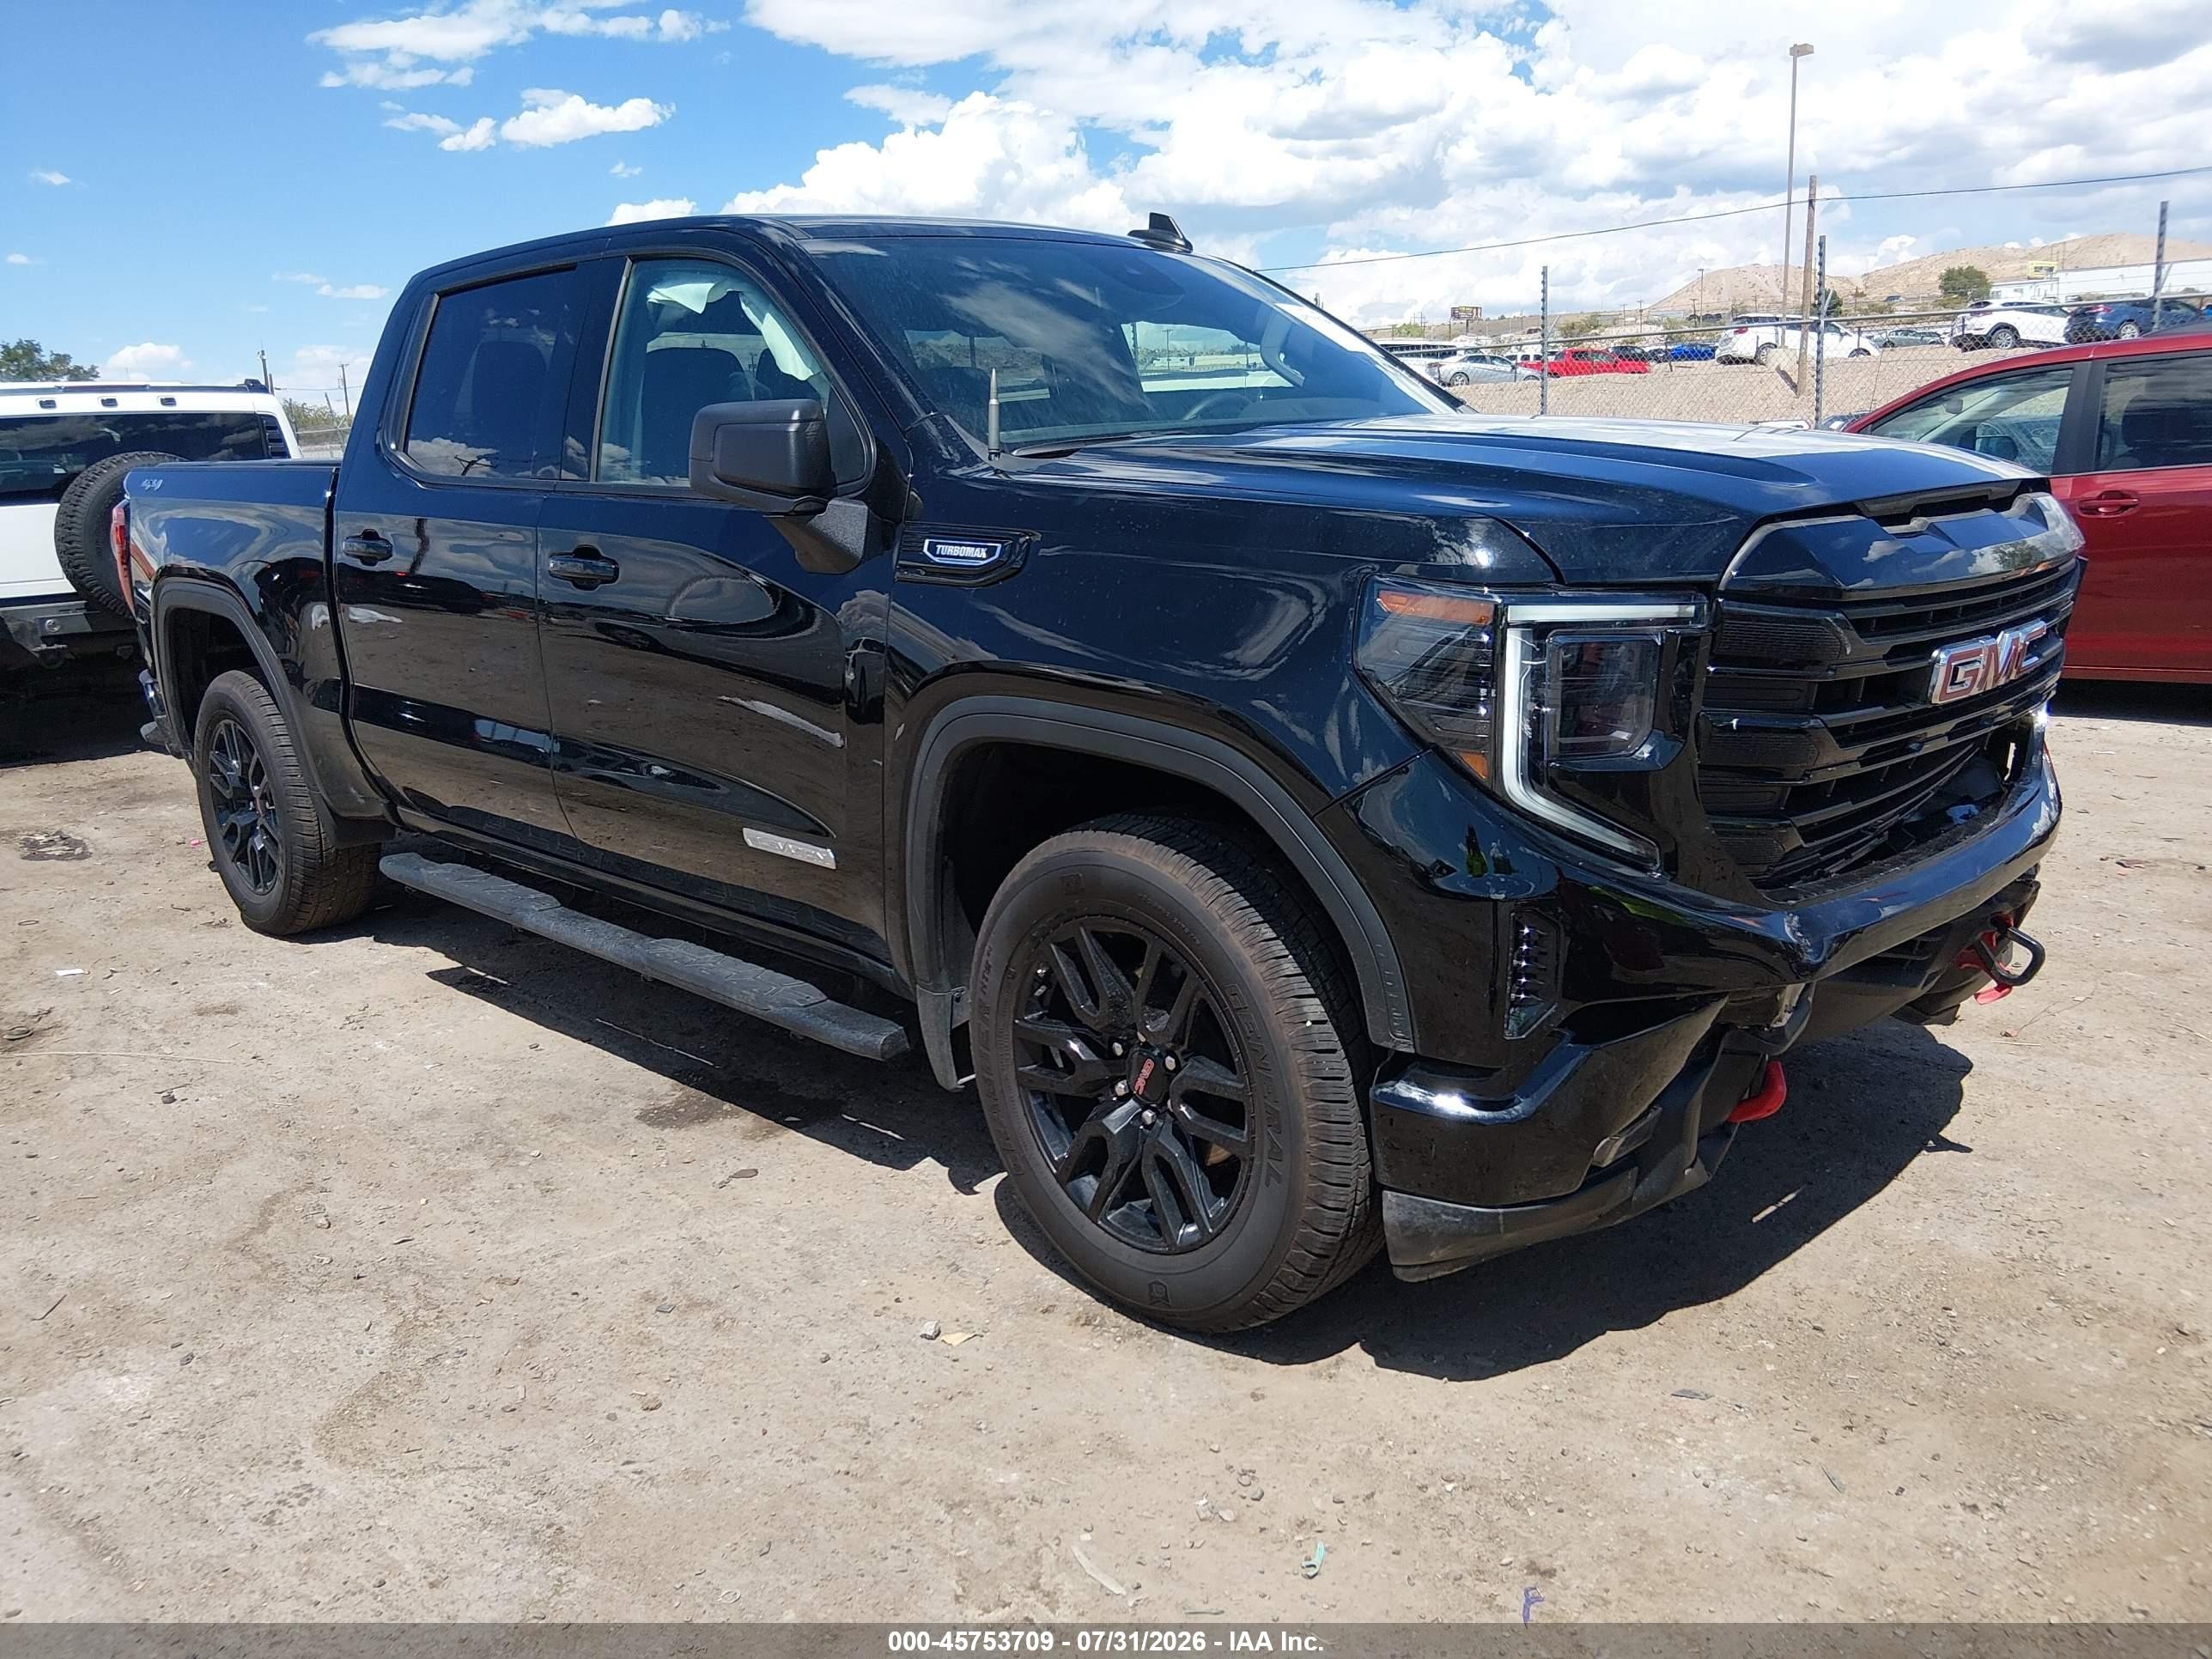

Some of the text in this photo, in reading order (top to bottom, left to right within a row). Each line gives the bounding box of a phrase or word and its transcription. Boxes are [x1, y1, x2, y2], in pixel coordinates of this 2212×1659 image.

[936, 544, 988, 558] TURBOMAX
[1928, 618, 2047, 705] GMC
[1134, 1058, 1155, 1096] GMC
[1222, 983, 1283, 1188] GENERAL
